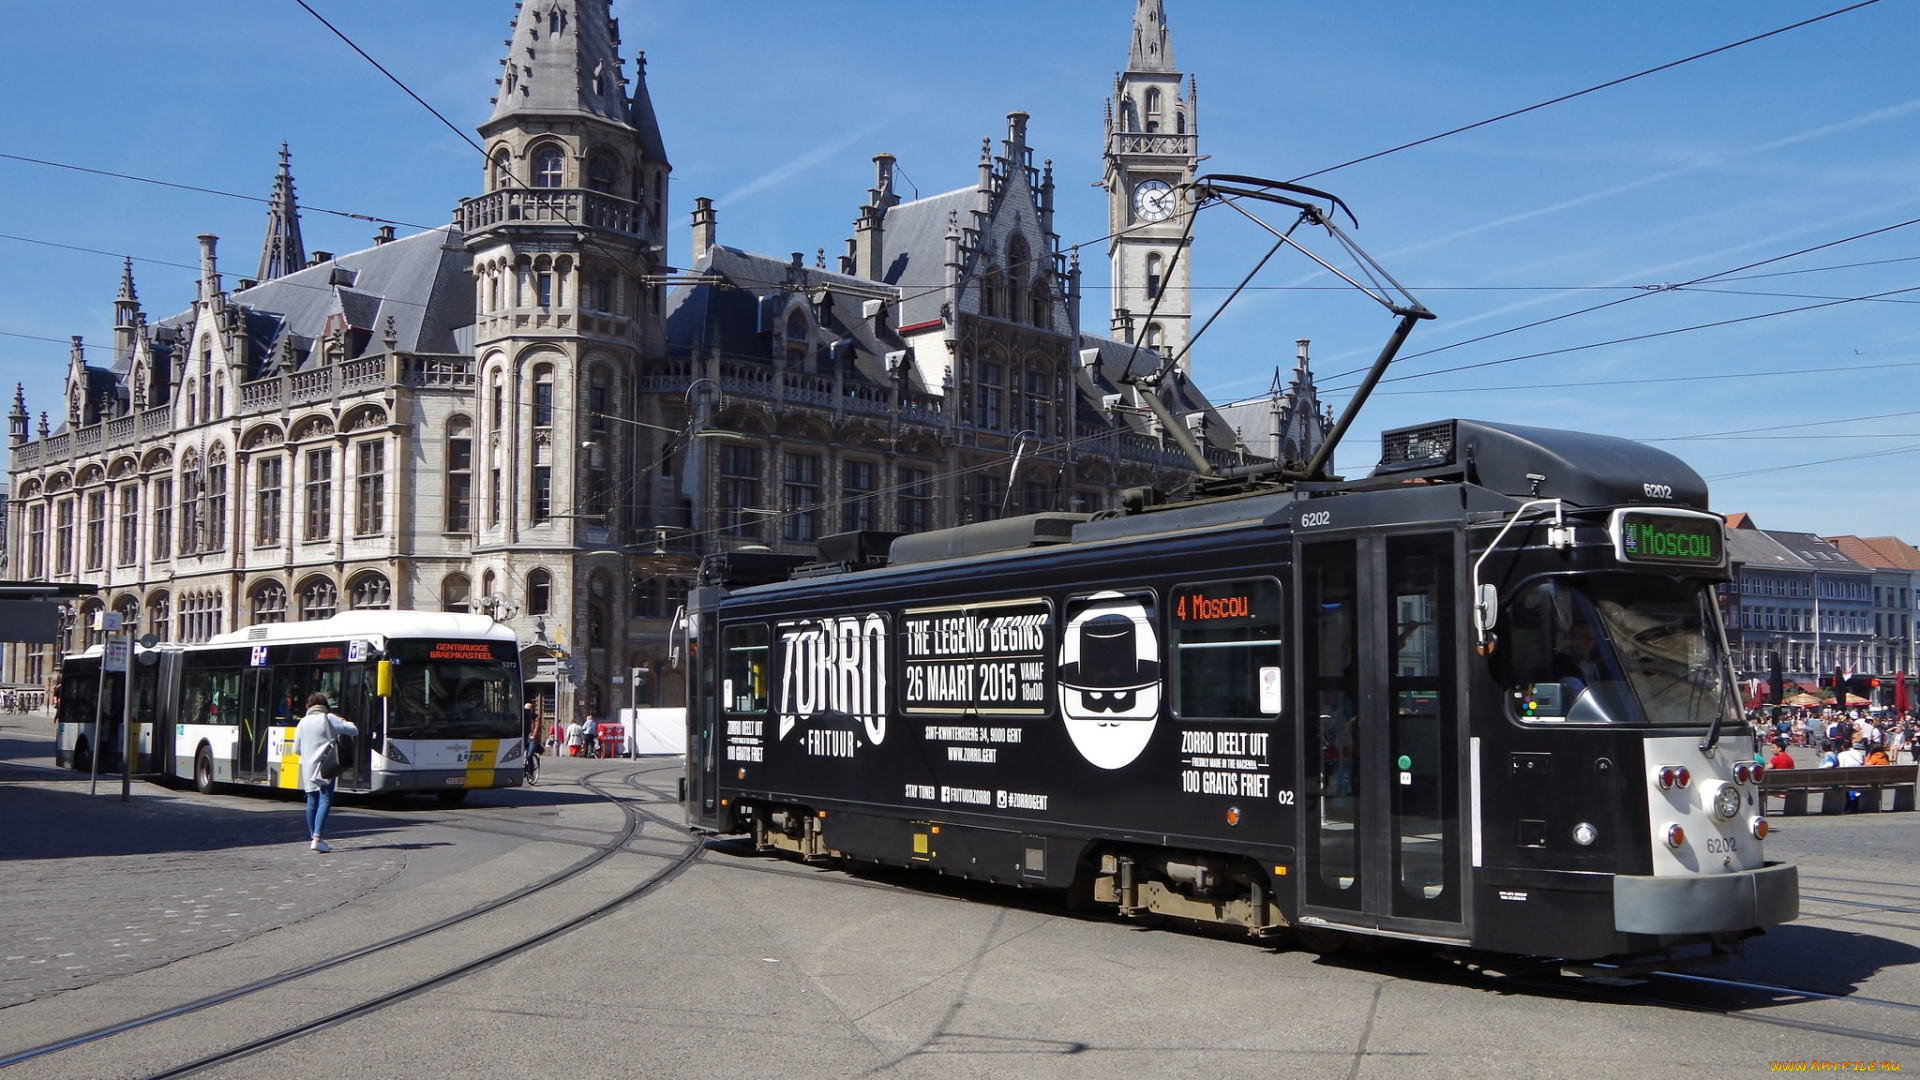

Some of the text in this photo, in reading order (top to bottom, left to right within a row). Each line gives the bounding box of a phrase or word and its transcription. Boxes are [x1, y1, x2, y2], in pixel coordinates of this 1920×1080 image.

[1643, 483, 1673, 499] 6202
[1301, 510, 1330, 528] 6202
[1641, 524, 1711, 558] Moscou
[1177, 594, 1248, 621] 4 Moscou
[108, 619, 115, 628] 2
[906, 613, 1049, 655] THE LEGEND BEGINS
[430, 651, 494, 660] BRAEMKASTEEL
[436, 643, 490, 652] GENTBRUGGE
[502, 661, 517, 669] 5372
[1020, 662, 1044, 681] VANAF
[779, 612, 887, 746] ZORRO
[906, 663, 1017, 701] 26 MAART 2015
[808, 729, 855, 758] FRITUUR
[990, 727, 1006, 743] 9000
[1006, 728, 1022, 743] GENT
[1181, 731, 1269, 756] ZORRO DEELT UIT
[905, 784, 935, 800] STAY TUNED
[1181, 770, 1270, 798] 100 GRATIS FRIET
[1278, 790, 1294, 805] 02
[1707, 837, 1738, 853] 6202
